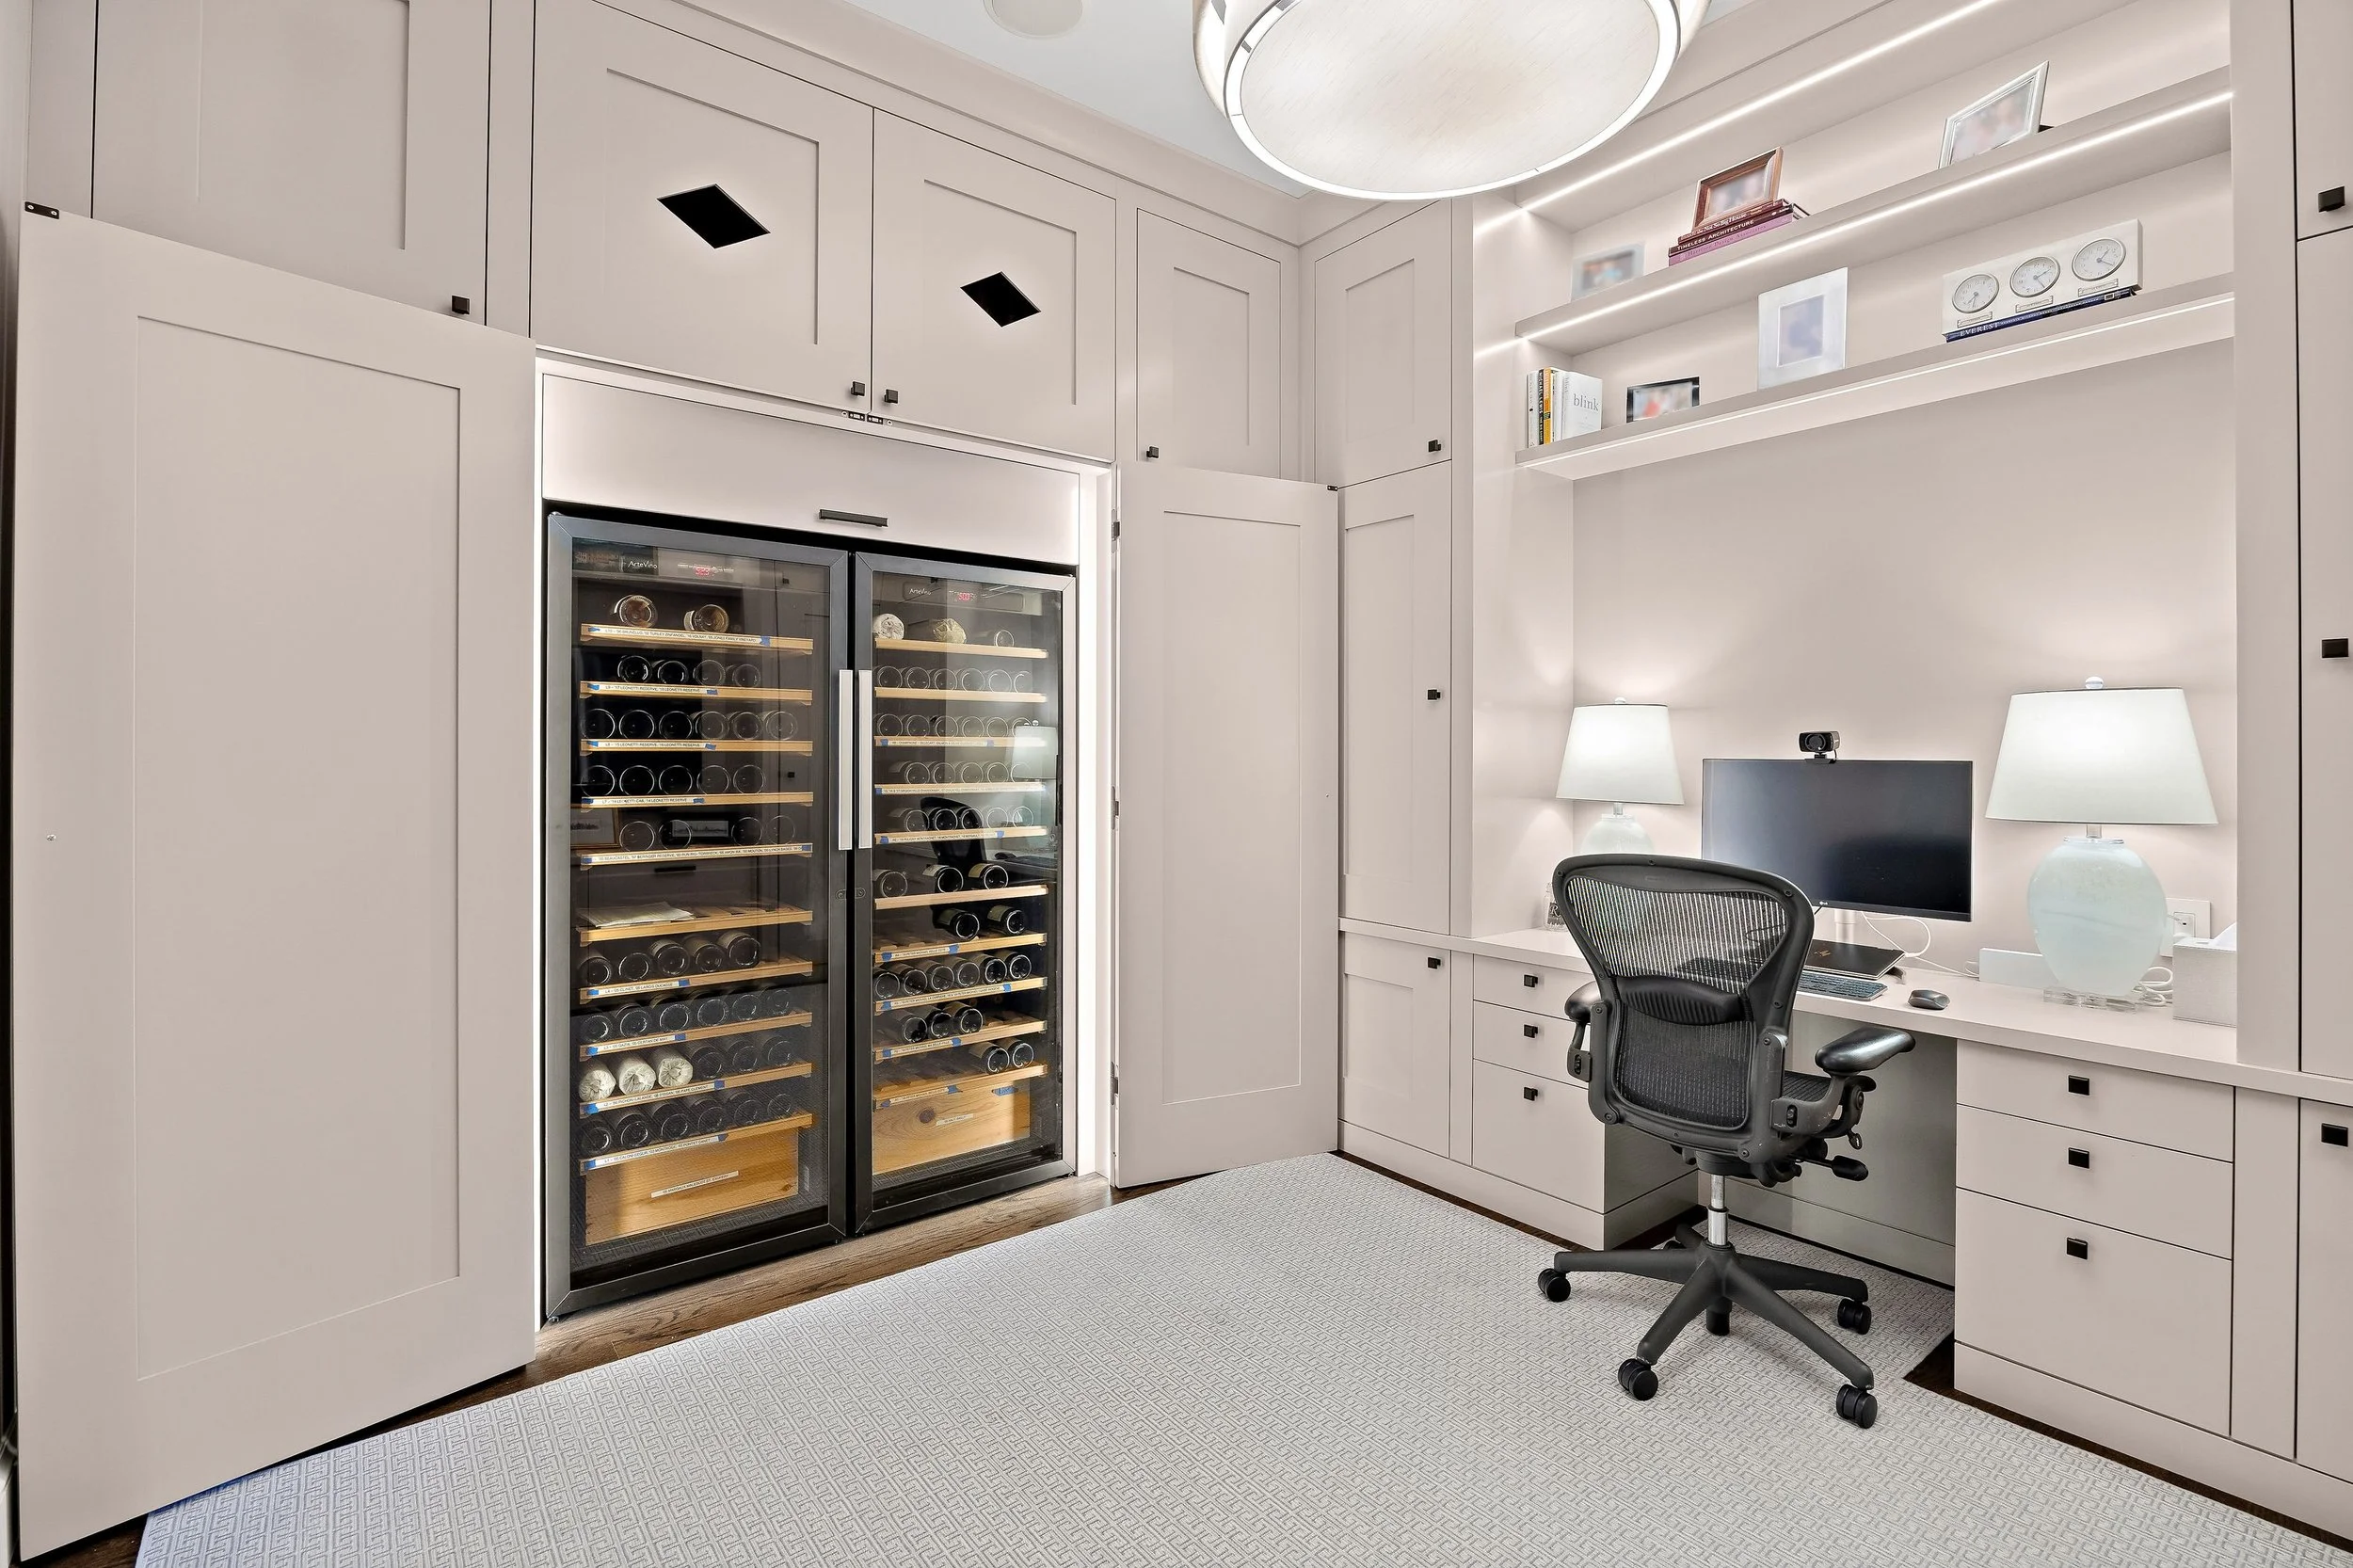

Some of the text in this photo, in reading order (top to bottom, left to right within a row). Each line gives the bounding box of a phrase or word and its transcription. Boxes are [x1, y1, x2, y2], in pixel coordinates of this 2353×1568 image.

[1729, 213, 1747, 223] House
[1677, 220, 1754, 251] TIMELESS ARCHITECTURE
[1714, 237, 1734, 248] Design
[1960, 322, 2000, 337] EVEREST
[1574, 393, 1599, 411] blink
[627, 561, 657, 569] ArteVino
[1549, 904, 1561, 918] R
